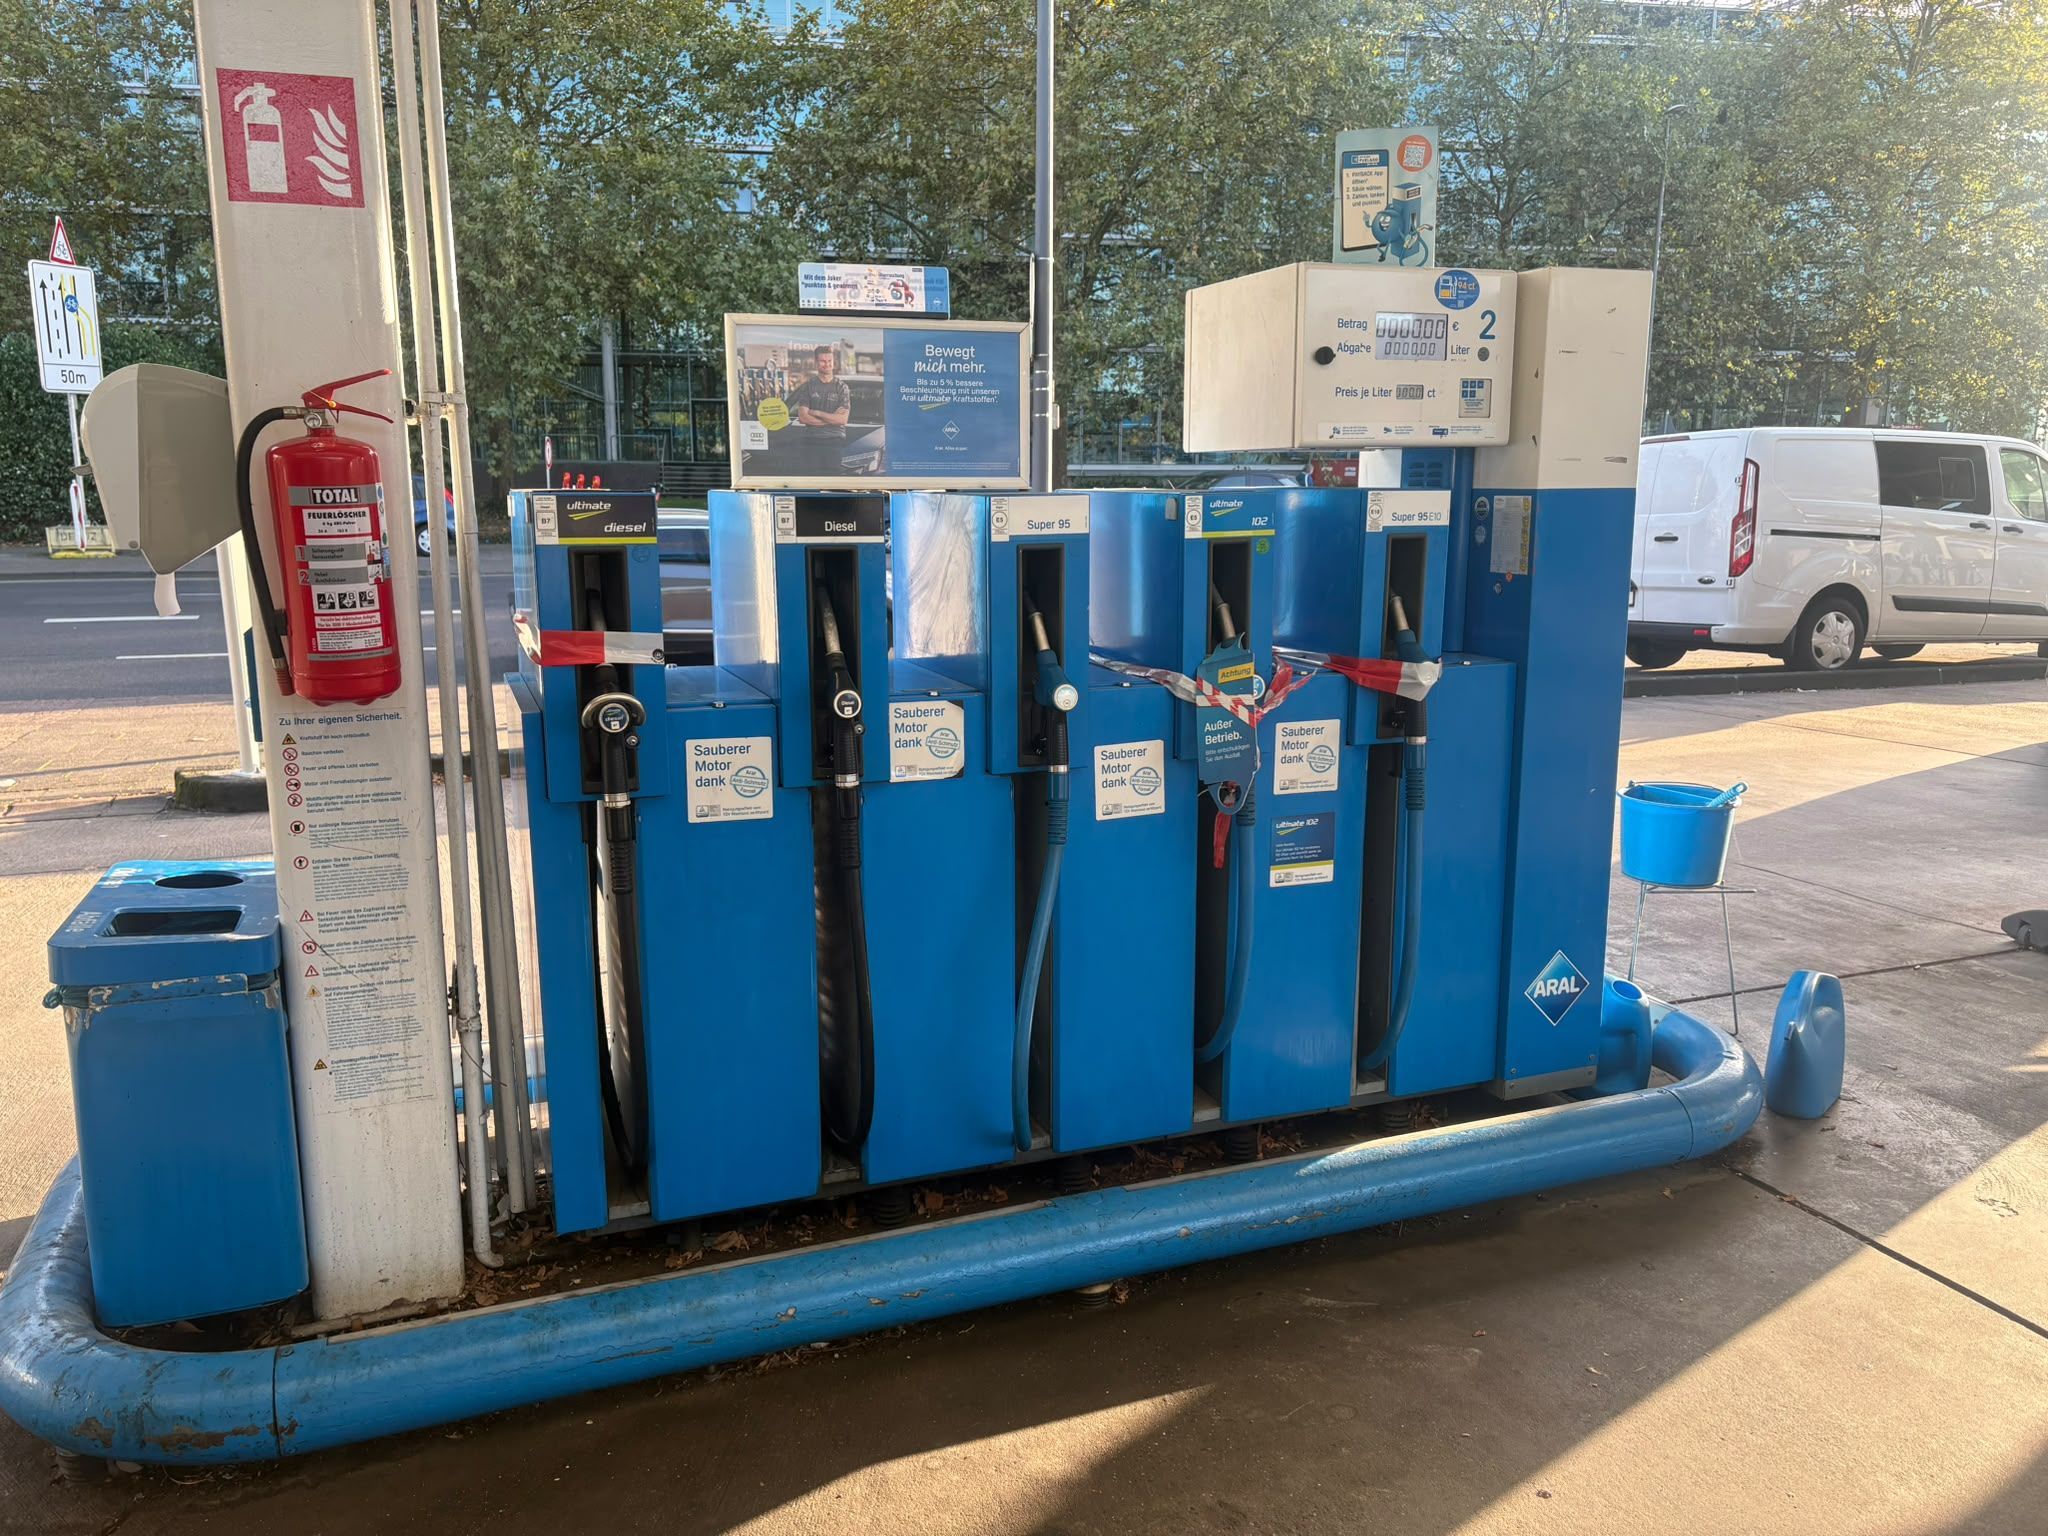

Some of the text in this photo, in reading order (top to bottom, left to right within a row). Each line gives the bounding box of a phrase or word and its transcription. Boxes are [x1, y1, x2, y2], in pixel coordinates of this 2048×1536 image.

[1337, 317, 1368, 331] Betrag
[1452, 321, 1459, 331] €
[1479, 310, 1497, 340] 2
[925, 344, 976, 360] Bewegt
[1336, 342, 1371, 354] Abgabe
[1451, 345, 1470, 355] Liter
[914, 359, 986, 374] mich mehr.
[61, 369, 87, 384] 50m
[900, 386, 956, 395] Beschleunigung
[1335, 387, 1392, 400] Preis je Liter
[1427, 388, 1436, 398] ct
[313, 488, 358, 503] TOTAL
[567, 501, 612, 510] ultimate
[1209, 500, 1244, 508] ultimate
[307, 510, 367, 519] FEUERLÖSCHER
[1391, 512, 1416, 523] Super
[825, 521, 856, 532] Diesel
[1027, 519, 1071, 531] Super 95
[1251, 517, 1268, 526] 102
[604, 522, 646, 533] diesel
[300, 571, 309, 584] 2
[327, 593, 335, 601] A
[348, 592, 355, 600] B
[367, 591, 374, 599] C
[1220, 667, 1252, 679] Achtung
[893, 707, 945, 718] Sauberer
[279, 711, 402, 726] Zu Ihrer eigenen Sicherheit.
[895, 723, 928, 733] Motor
[1204, 720, 1233, 732] Außer
[1281, 727, 1325, 737] Sauberer
[895, 737, 922, 748] dank
[1205, 731, 1242, 745] Betrieb.
[694, 744, 751, 756] Sauberer
[1281, 741, 1309, 750] Motor
[1101, 748, 1147, 760] Sauberer
[1281, 754, 1304, 764] dank
[695, 760, 732, 771] Motor
[1101, 763, 1131, 775] Motor
[695, 775, 726, 787] dank
[1102, 777, 1127, 788] dank
[1276, 818, 1319, 828] ultimate 102
[1534, 976, 1580, 998] ARAL
